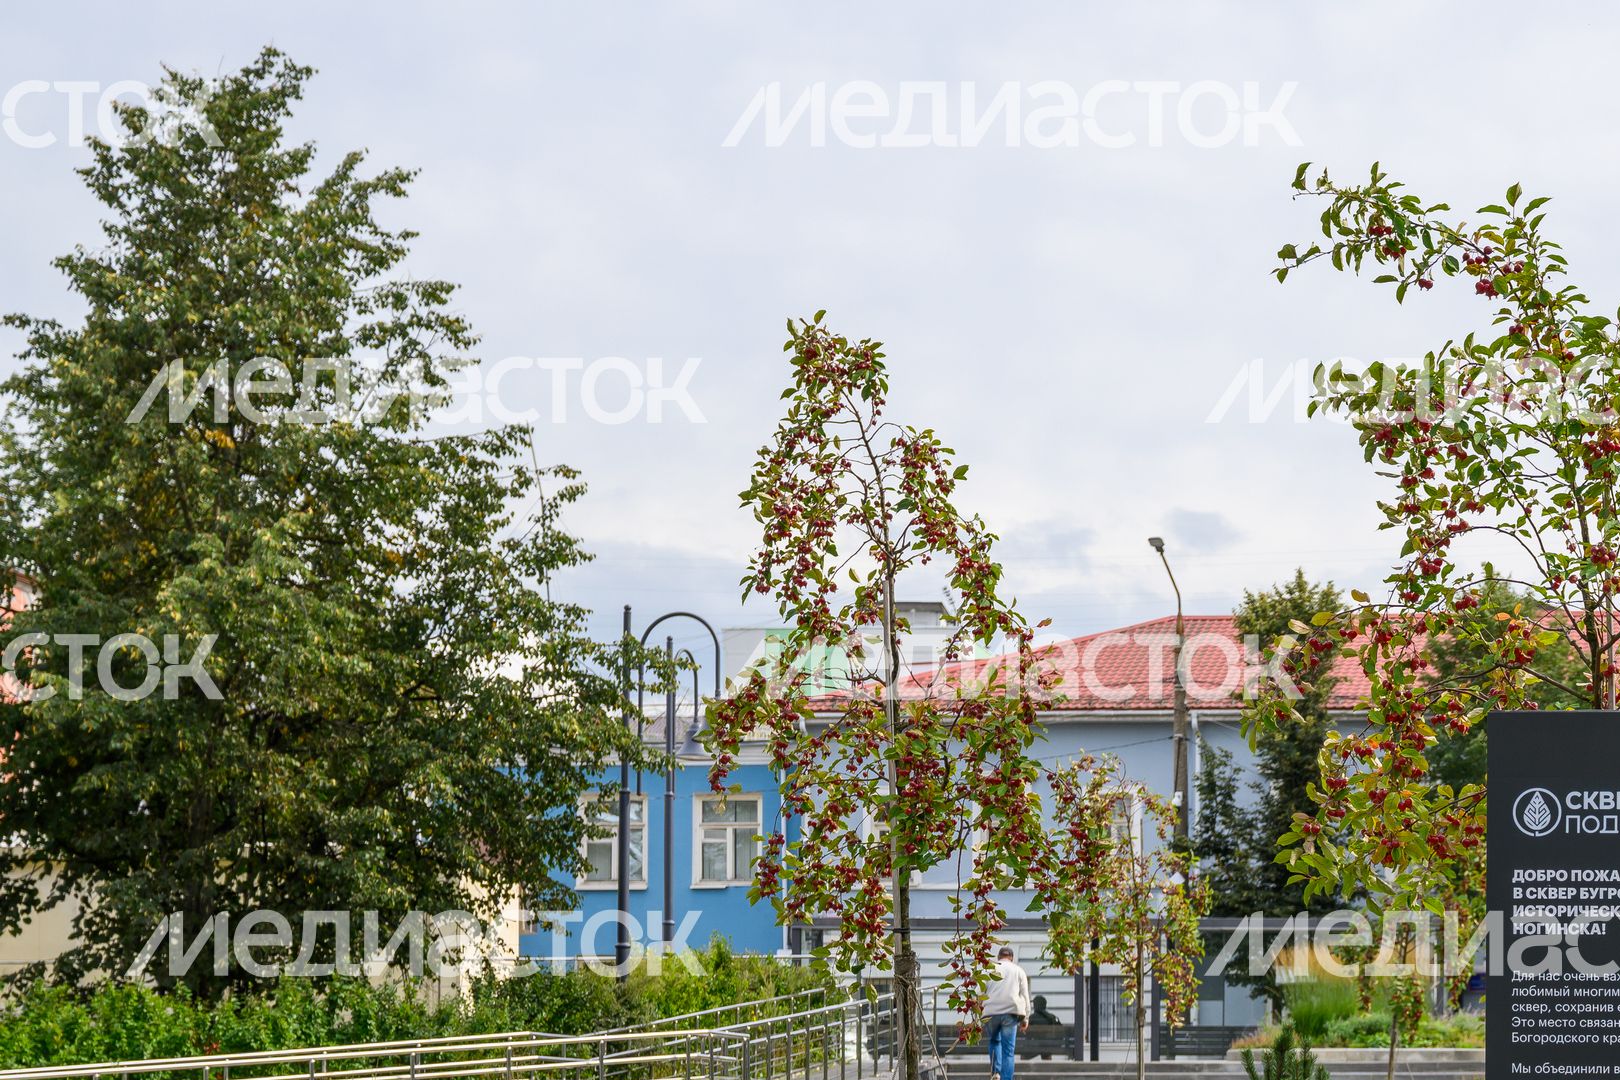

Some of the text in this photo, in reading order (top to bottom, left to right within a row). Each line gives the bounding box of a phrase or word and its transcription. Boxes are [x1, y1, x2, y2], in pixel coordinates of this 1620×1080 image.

[1511, 869, 1569, 884] ДОБРО
[1512, 886, 1524, 900] В
[1525, 886, 1578, 900] СКВЕР
[1513, 922, 1606, 936] НОГИНСКА!
[1511, 969, 1535, 982] Для
[1538, 972, 1560, 981] нас
[1563, 972, 1600, 981] очень
[1511, 984, 1571, 997] любимый
[1511, 1003, 1552, 1015] сквер,
[1554, 1003, 1615, 1015] сохранив
[1511, 1015, 1536, 1028] Это
[1538, 1018, 1577, 1028] место
[1511, 1031, 1600, 1046] Богородского
[1511, 1062, 1532, 1074] Мы
[1534, 1061, 1611, 1076] объединили
[1613, 1065, 1620, 1075] в
